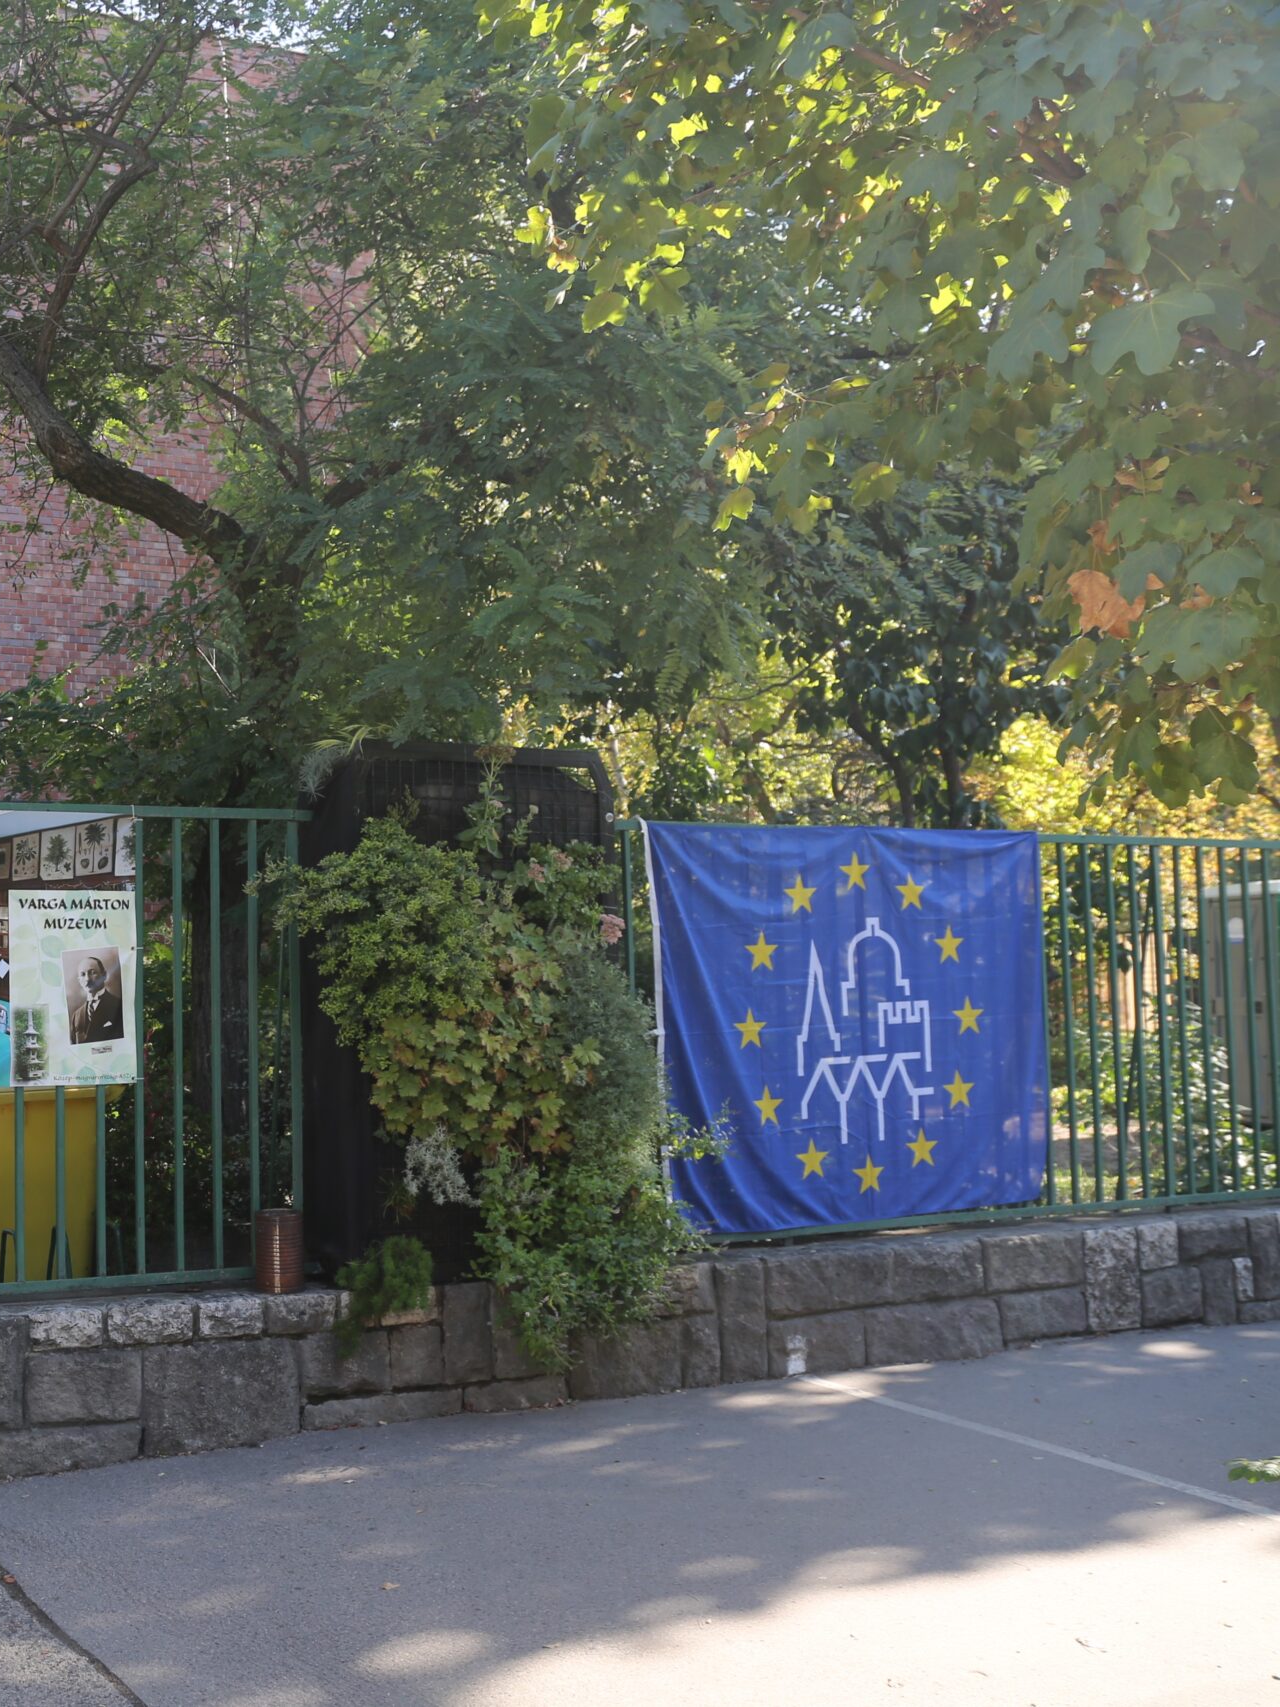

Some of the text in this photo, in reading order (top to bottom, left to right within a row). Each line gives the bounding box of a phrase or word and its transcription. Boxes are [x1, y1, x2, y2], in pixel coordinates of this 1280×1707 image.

[18, 896, 130, 910] VARGA MÁRTON
[43, 916, 107, 930] MÚZEUM
